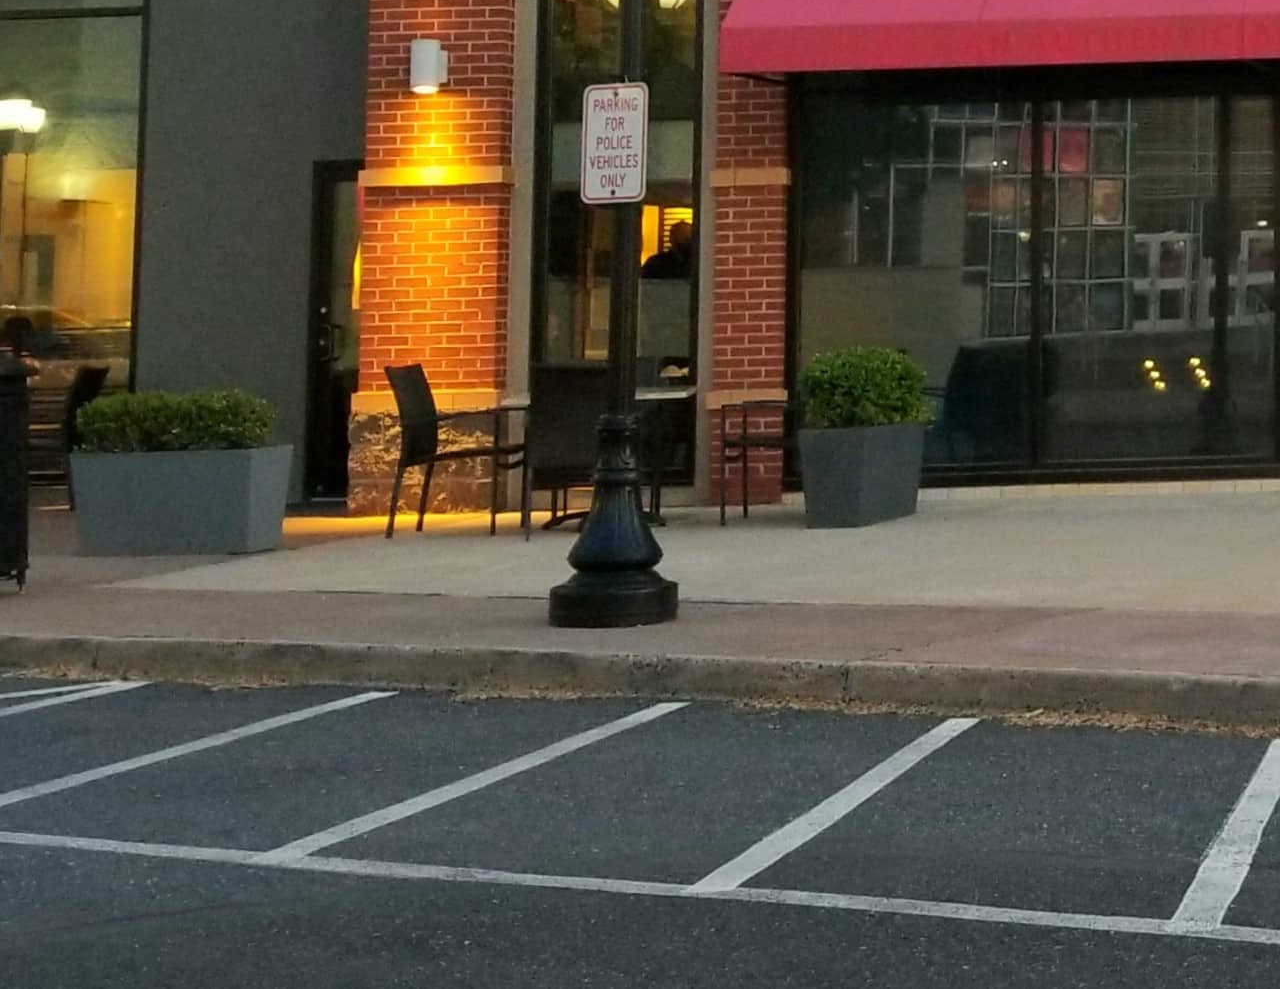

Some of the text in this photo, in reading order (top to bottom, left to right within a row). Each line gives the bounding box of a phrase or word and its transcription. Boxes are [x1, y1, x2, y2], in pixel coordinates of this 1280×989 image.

[593, 97, 639, 113] PARKING
[605, 117, 625, 131] FOR
[596, 135, 633, 150] POLICE
[589, 154, 639, 170] VEHICLES
[600, 173, 626, 188] ONLY
